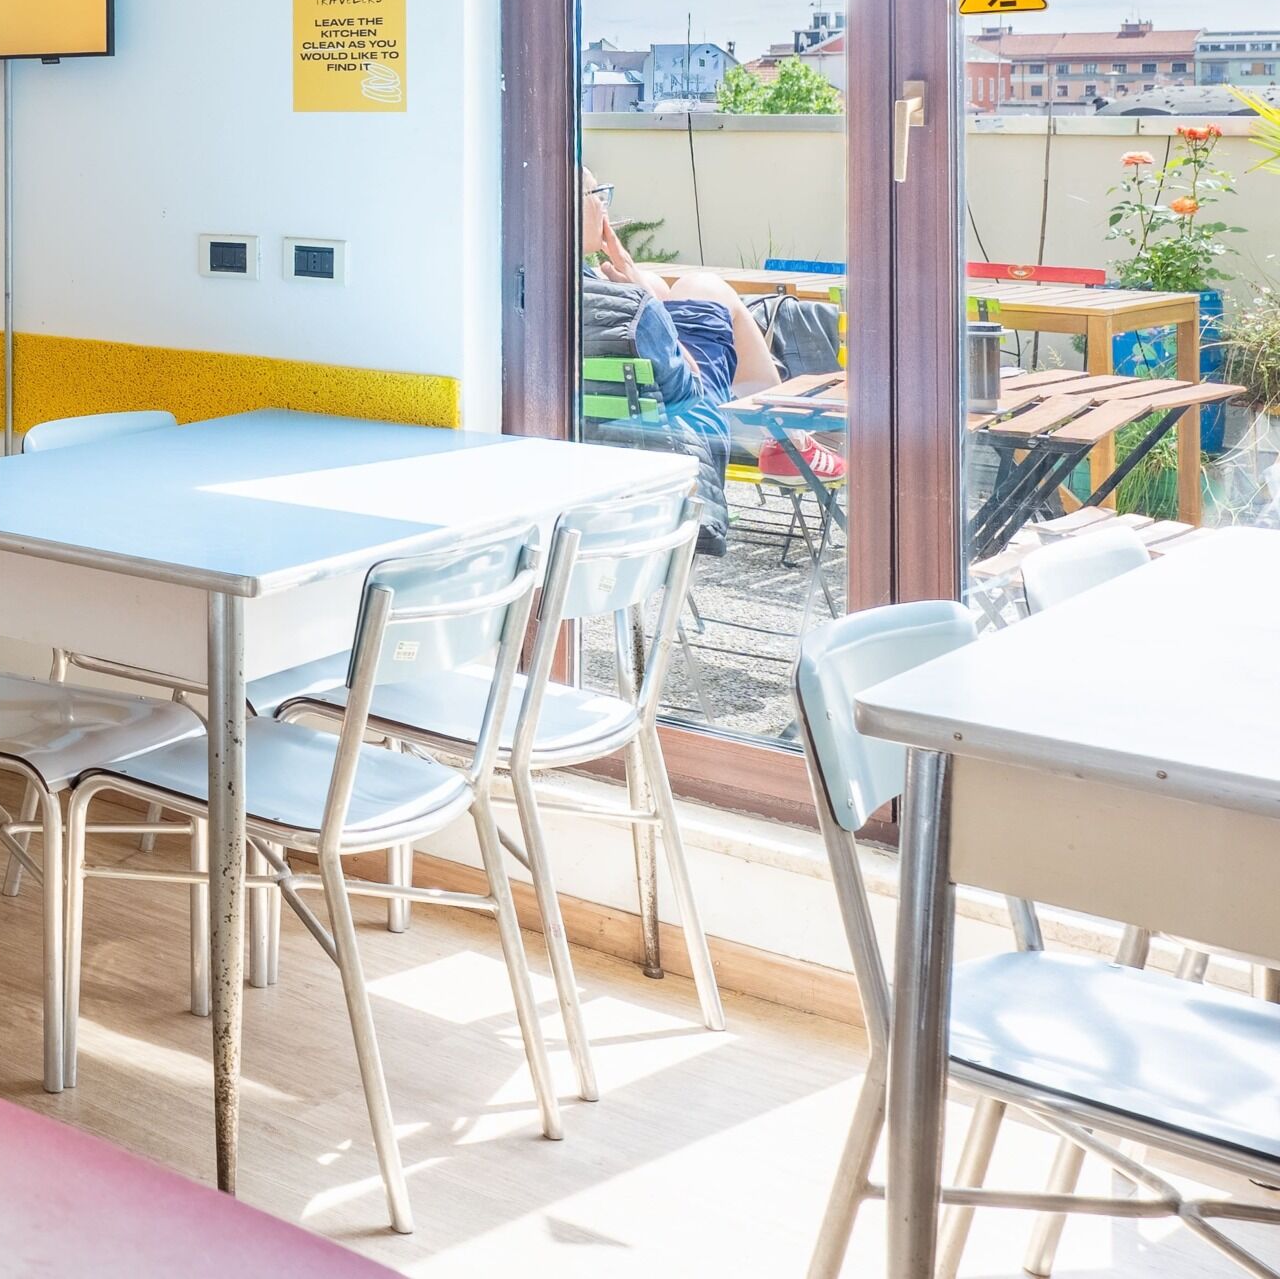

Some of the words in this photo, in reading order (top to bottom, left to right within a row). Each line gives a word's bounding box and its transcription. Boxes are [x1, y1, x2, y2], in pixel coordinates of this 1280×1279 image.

[314, 18, 355, 27] LEAVE
[357, 17, 384, 25] THE
[321, 29, 377, 38] KITCHEN
[302, 41, 346, 50] CLEAN
[348, 40, 366, 49] AS
[369, 39, 397, 48] YOU
[300, 52, 348, 61] WOULD
[350, 51, 378, 60] LIKE
[380, 50, 399, 59] TO
[327, 63, 357, 71] FIND
[360, 63, 371, 71] IT
